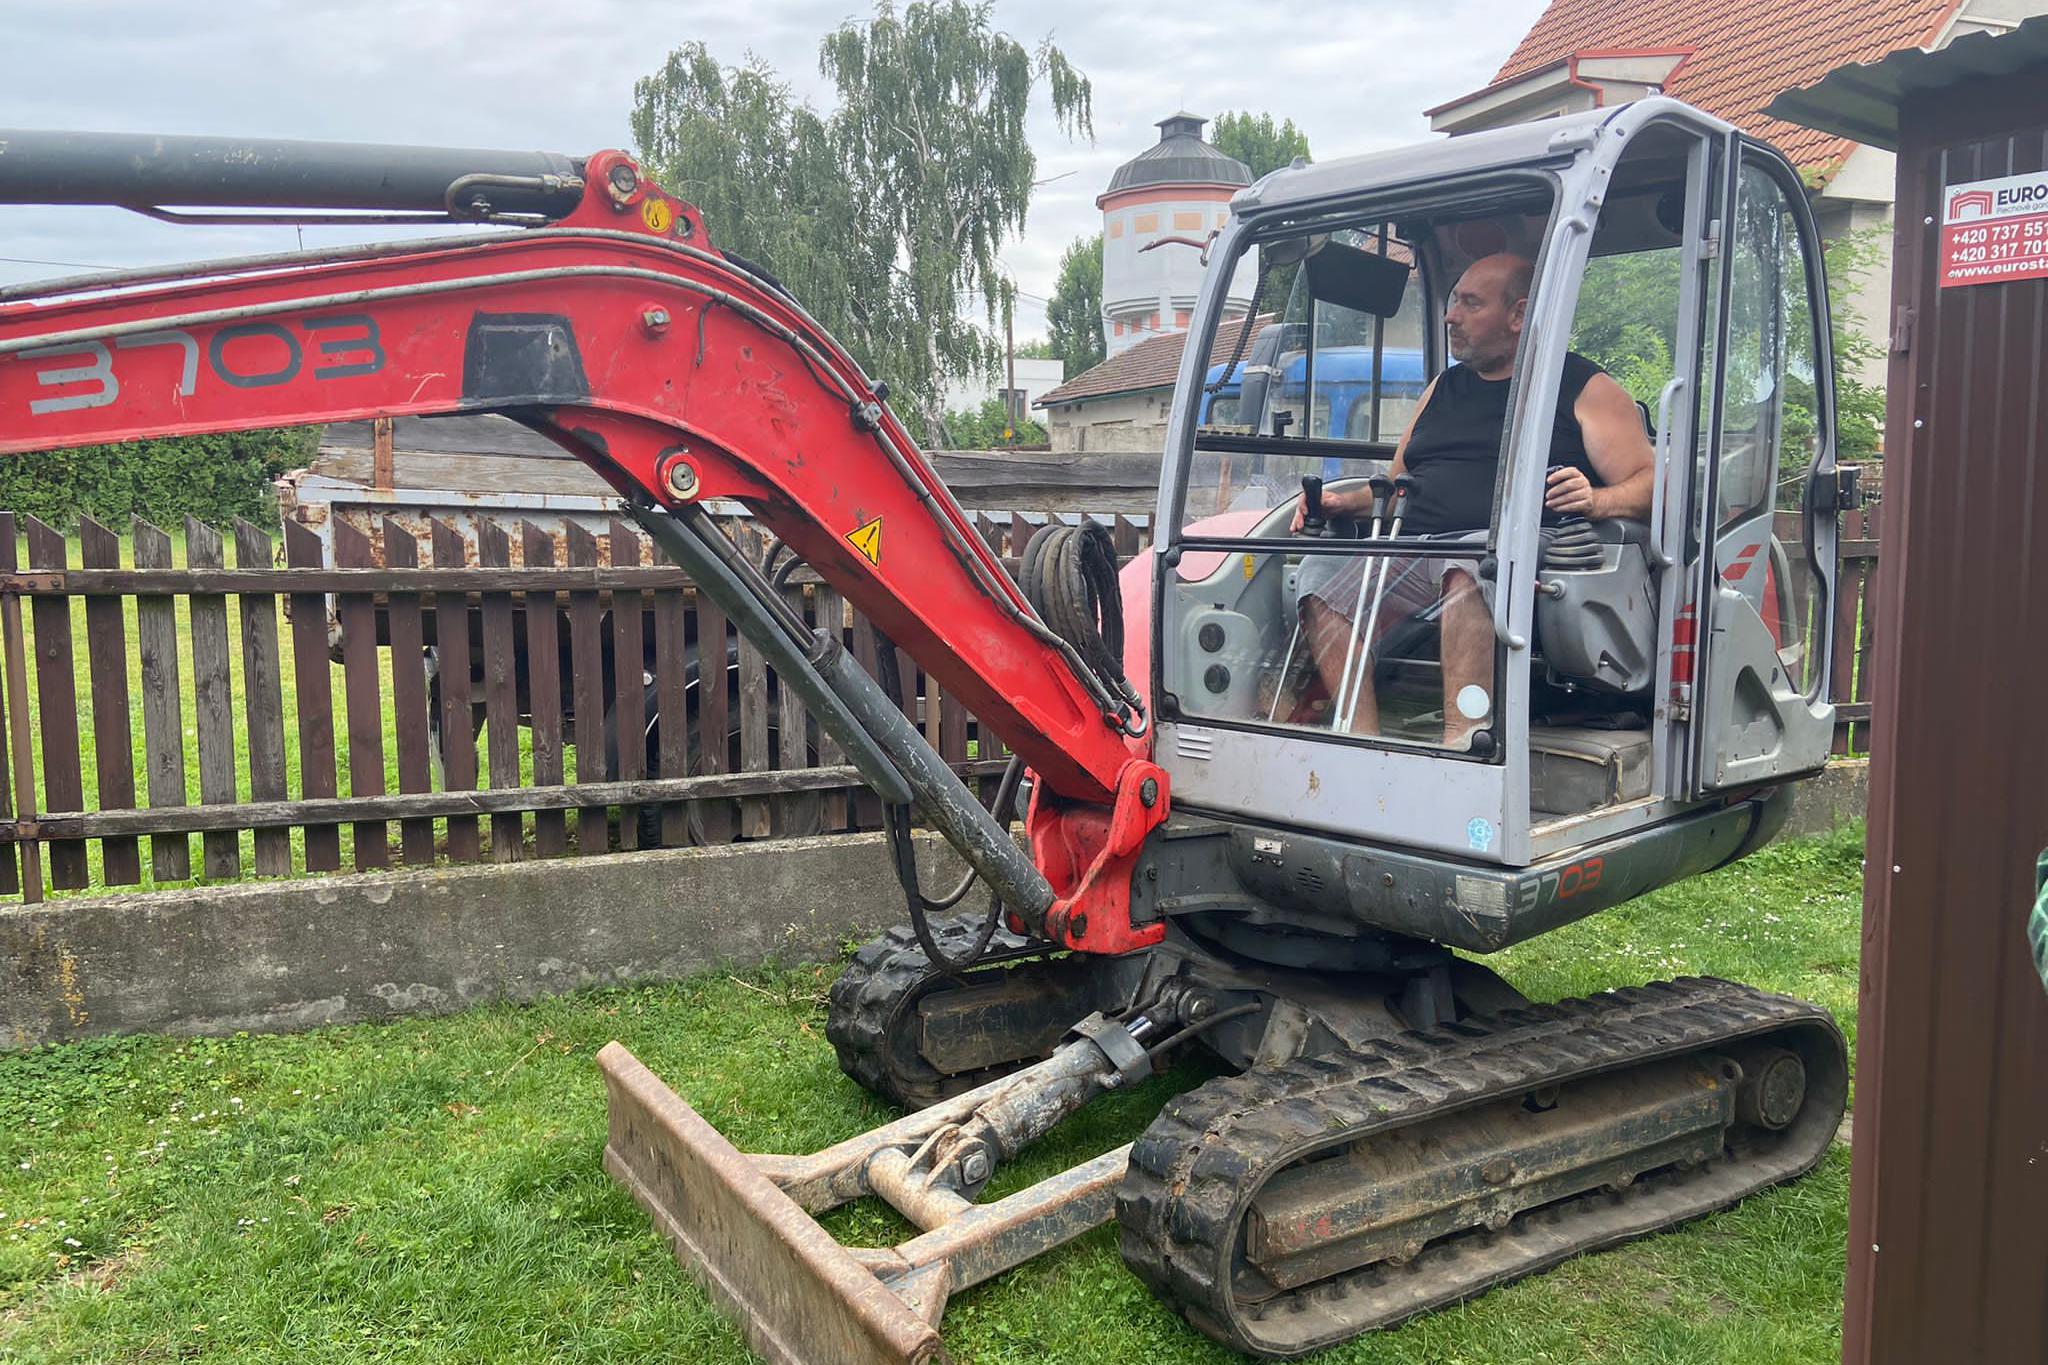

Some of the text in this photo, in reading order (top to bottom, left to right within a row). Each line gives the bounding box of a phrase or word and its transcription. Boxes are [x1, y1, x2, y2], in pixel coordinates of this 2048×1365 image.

[1951, 239, 2048, 262] +420 317 701
[1952, 229, 1987, 244] +420
[1991, 225, 2019, 241] 737
[17, 313, 385, 416] 3703
[1515, 857, 1605, 915] 3703
